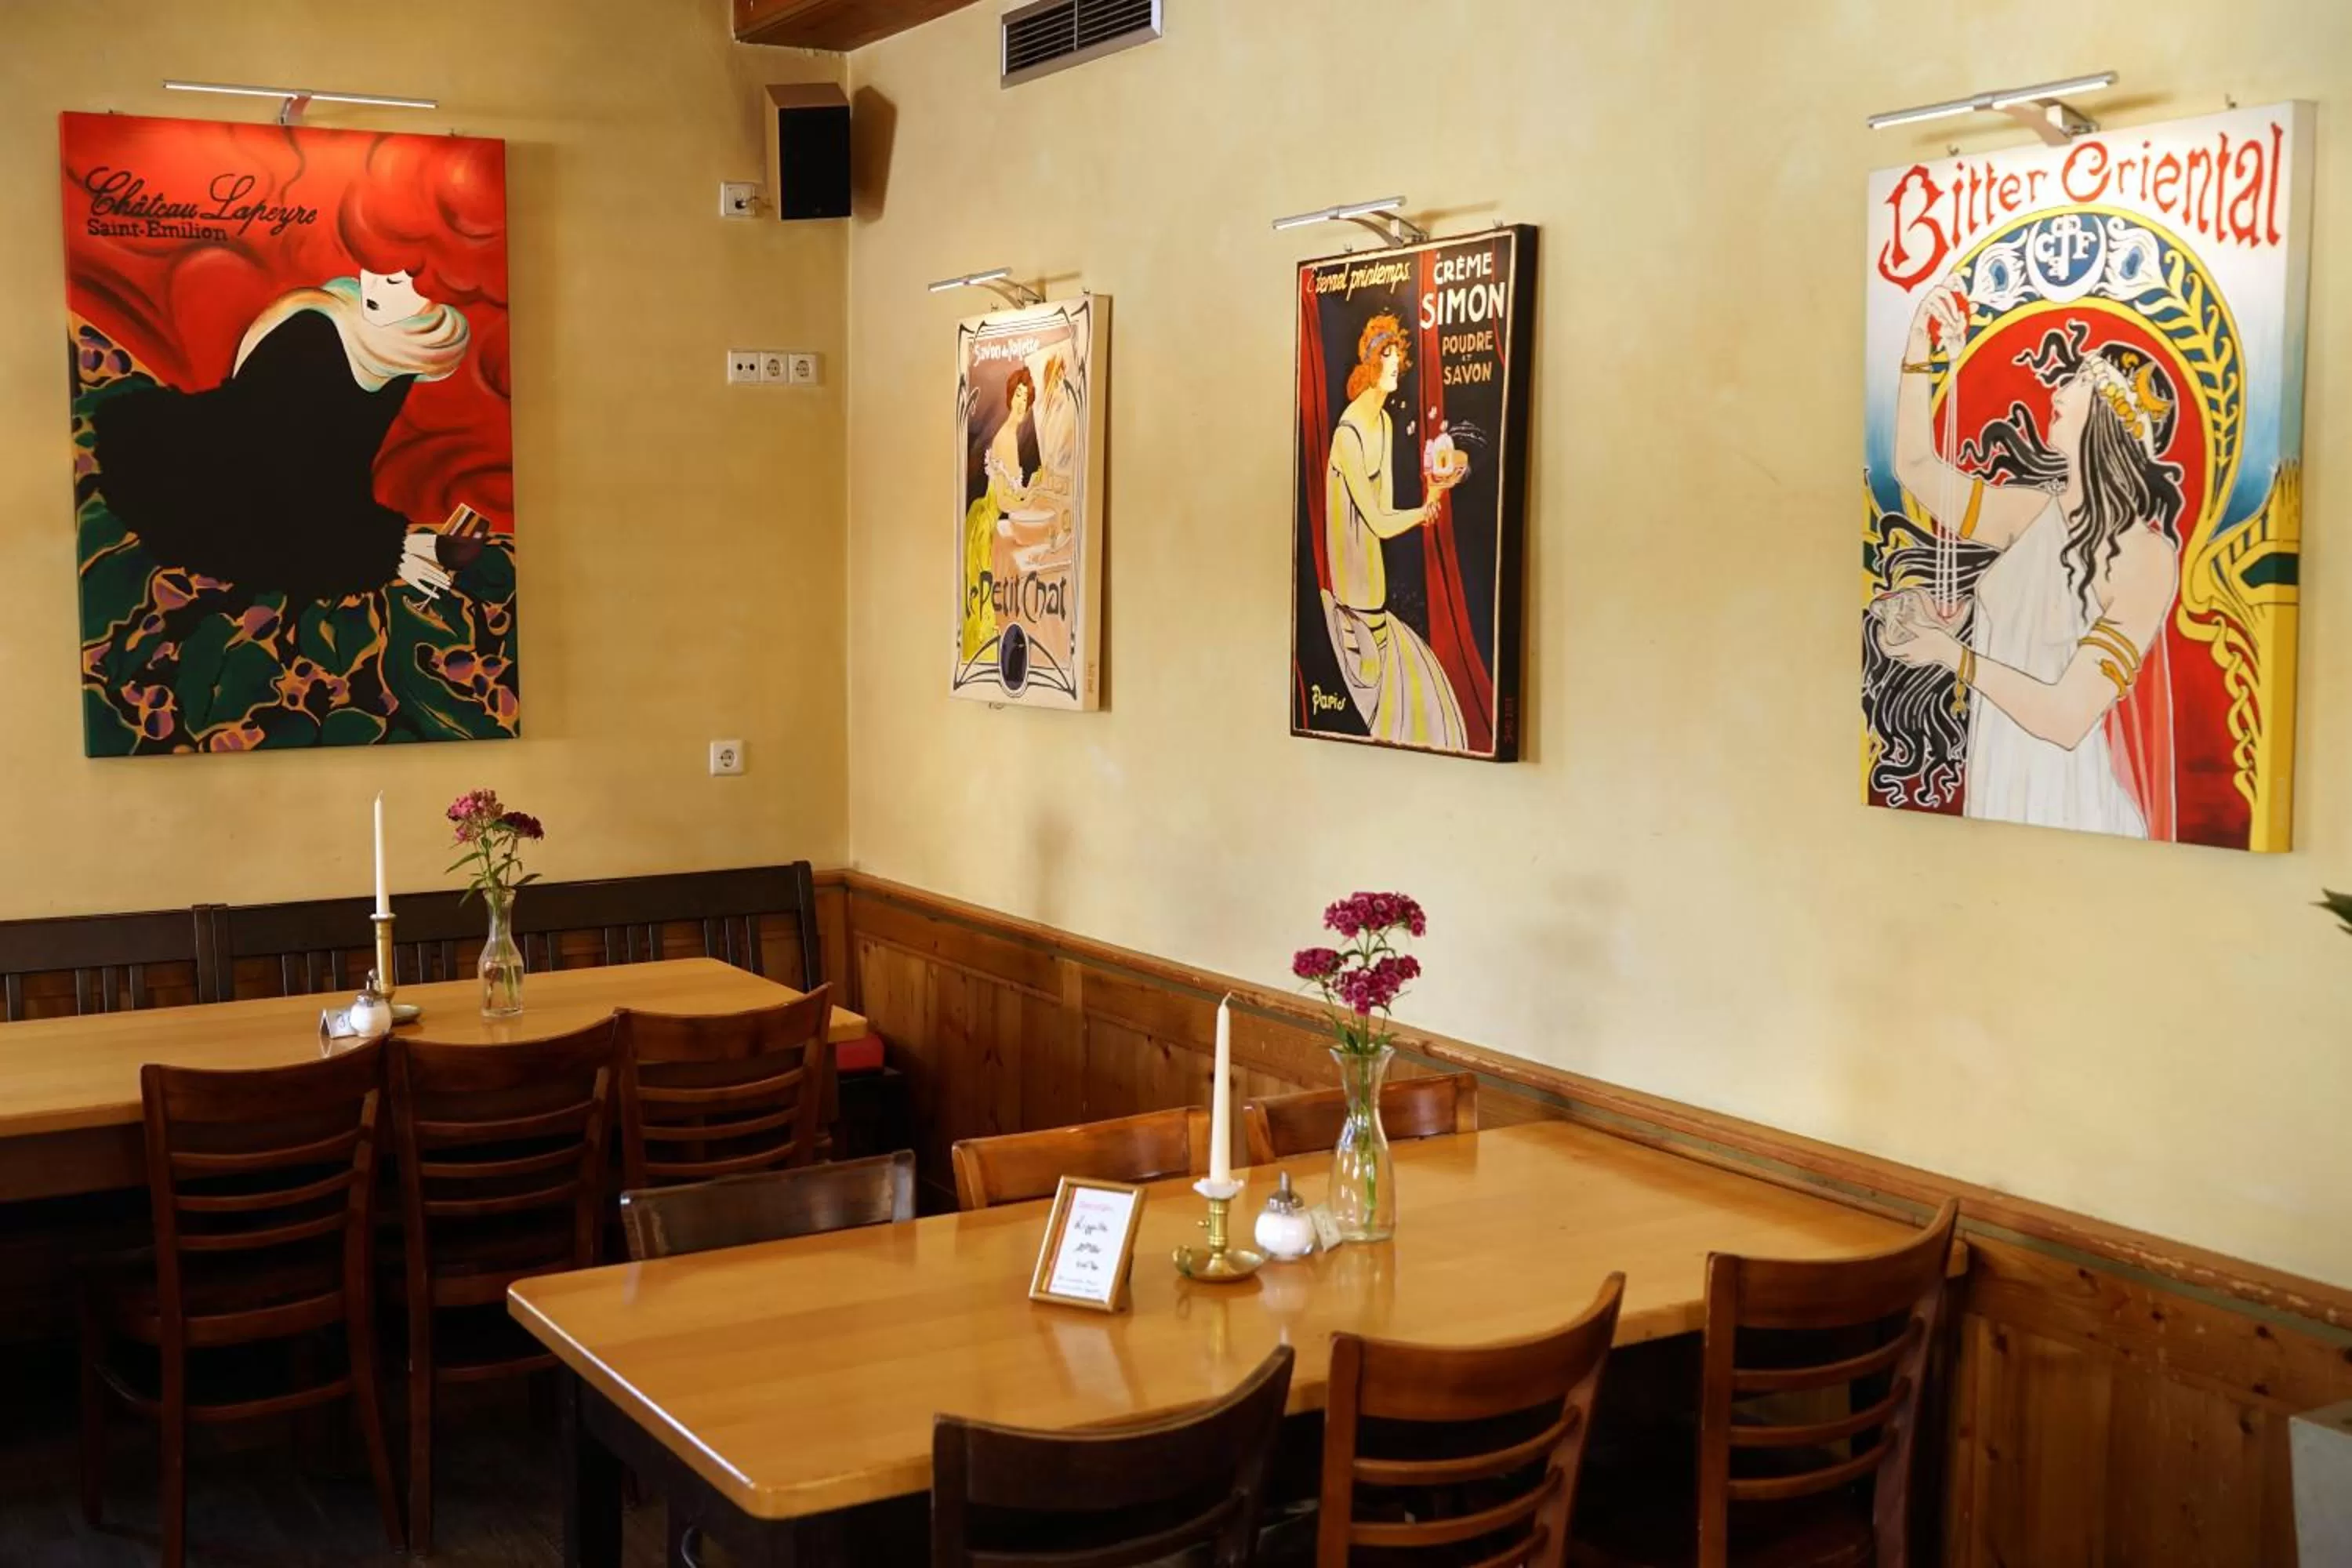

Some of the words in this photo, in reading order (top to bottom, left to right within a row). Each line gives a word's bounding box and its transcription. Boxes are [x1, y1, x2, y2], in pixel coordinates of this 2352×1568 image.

[85, 166, 198, 220] Château
[199, 173, 318, 236] Lapeyre
[1878, 164, 2049, 293] Bitter
[2061, 122, 2283, 248] Oriental
[1419, 281, 1506, 330] SIMON
[1442, 330, 1494, 356] POUDRE
[1443, 361, 1493, 386] SAVON
[979, 570, 1019, 622] Petit
[1023, 570, 1066, 623] Chat
